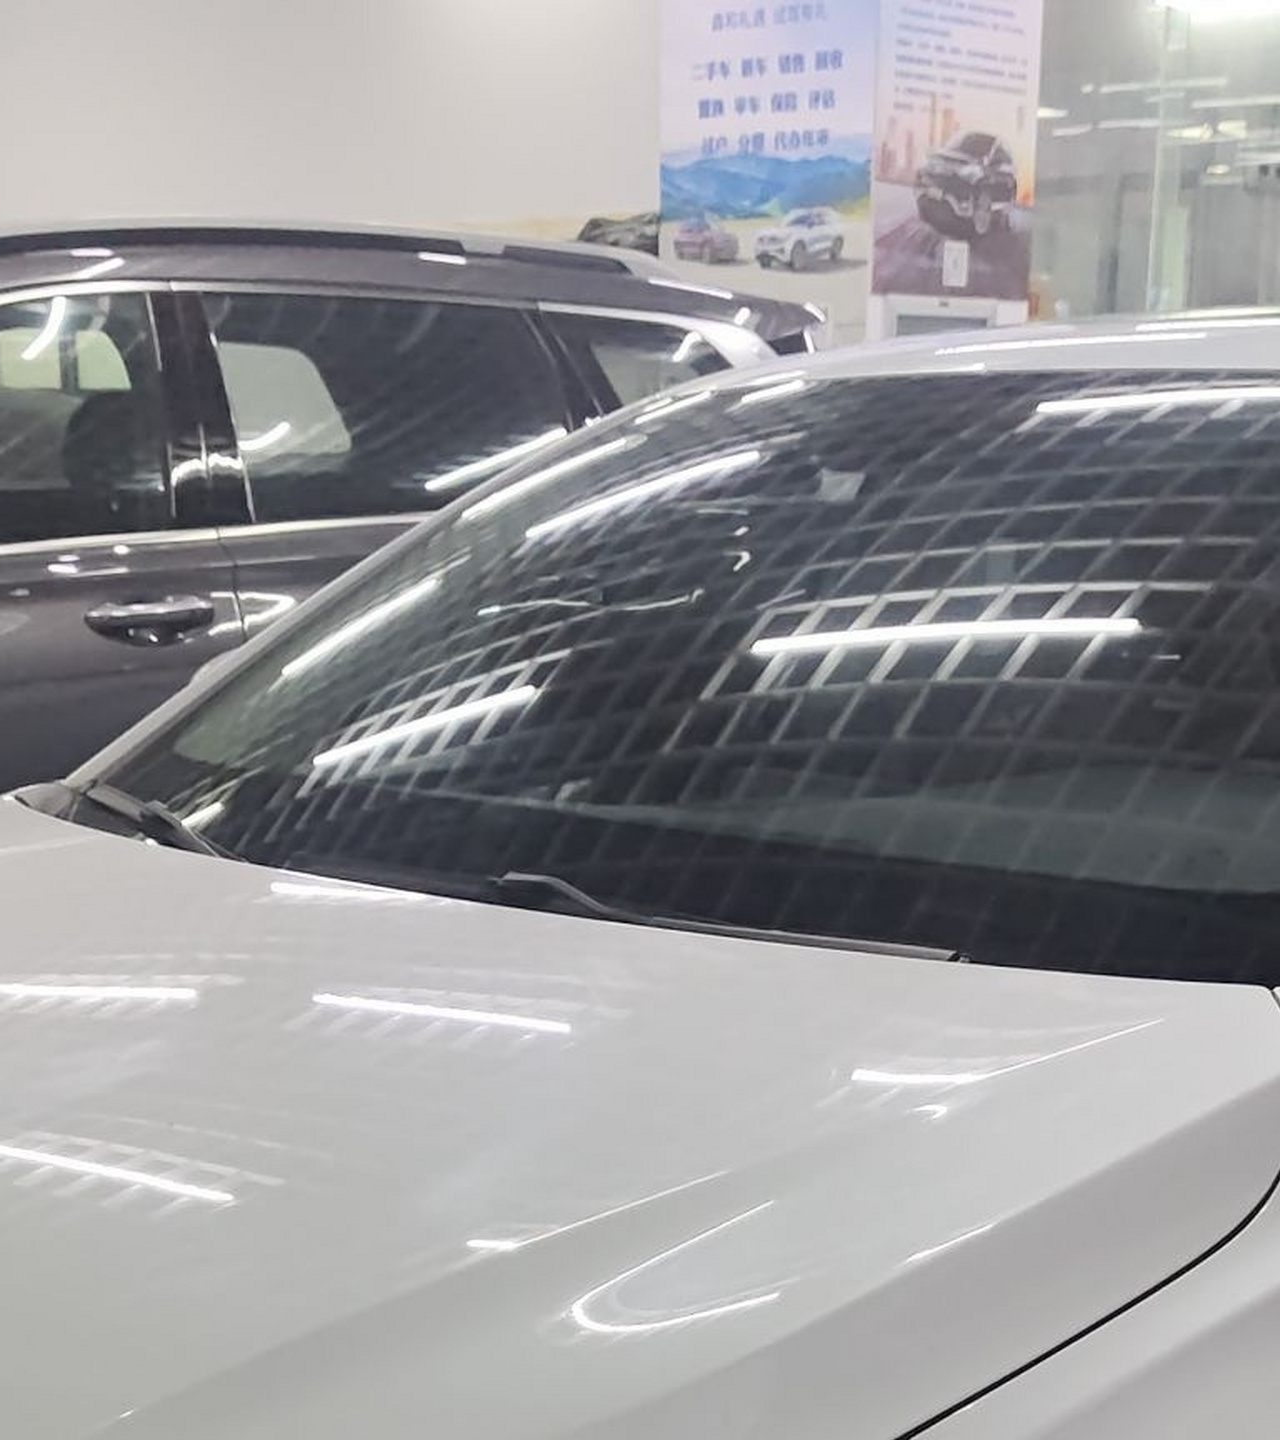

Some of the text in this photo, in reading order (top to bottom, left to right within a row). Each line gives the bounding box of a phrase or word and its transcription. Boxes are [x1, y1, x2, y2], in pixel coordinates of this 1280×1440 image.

[692, 60, 731, 82] 二手车
[771, 92, 798, 114] 保险
